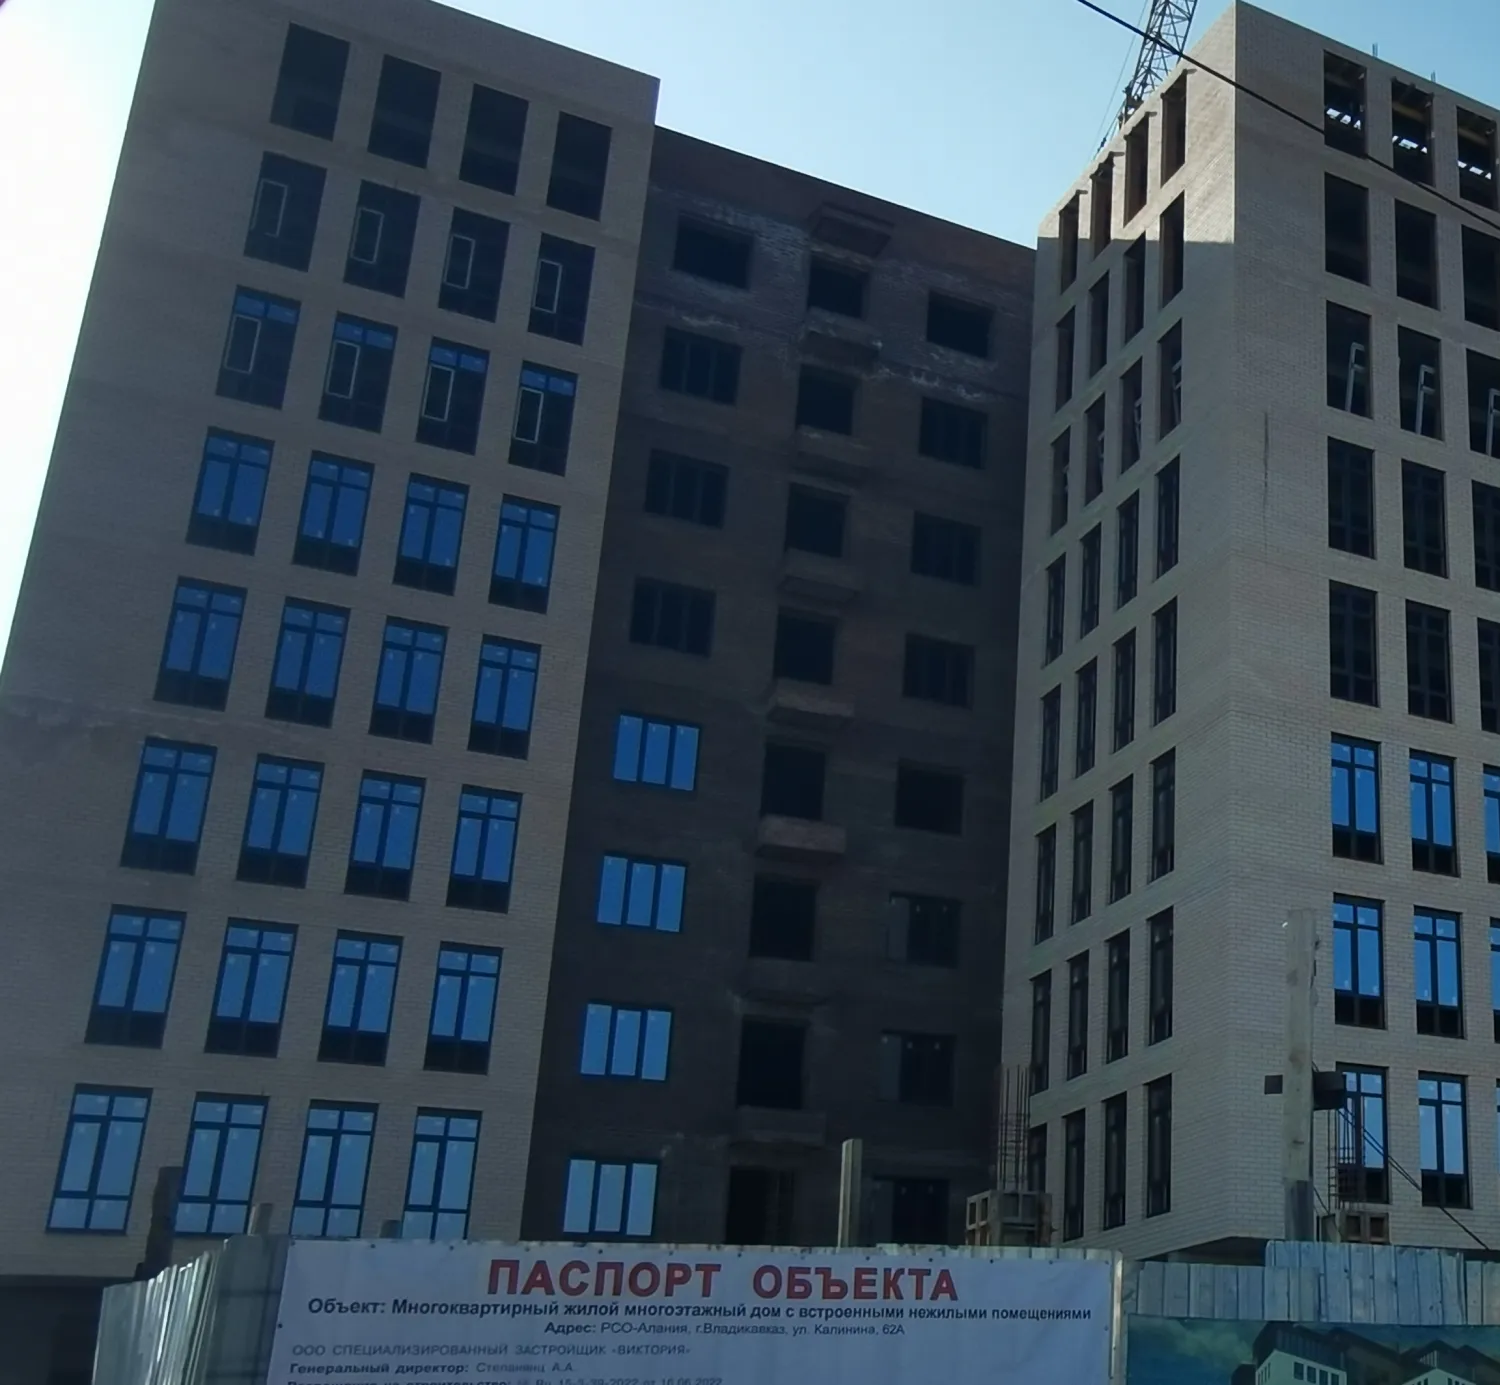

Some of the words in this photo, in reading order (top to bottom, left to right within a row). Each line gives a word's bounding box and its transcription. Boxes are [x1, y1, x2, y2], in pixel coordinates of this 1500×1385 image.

[487, 1259, 722, 1298] ПАСПОРТ
[753, 1265, 958, 1301] ОБЪЕКТА
[308, 1298, 386, 1314] Объект:
[391, 1299, 558, 1318] Многоквартирный
[564, 1302, 619, 1316] жилой
[624, 1304, 746, 1317] многоэтажный
[750, 1307, 780, 1319] дом
[785, 1307, 795, 1317] с
[799, 1307, 903, 1321] встроенными
[908, 1308, 987, 1319] нежилыми
[992, 1309, 1092, 1321] помещениями
[544, 1322, 596, 1336] Адрес:
[600, 1322, 691, 1335] РСО-Алания,
[695, 1323, 788, 1336] г.Владикавказ,
[814, 1324, 878, 1337] Калинина,
[882, 1323, 905, 1335] 62А
[292, 1344, 326, 1356] ООО
[332, 1344, 508, 1356] СПЕЦИАЛИЗИРОВАННЫЙ
[515, 1344, 607, 1356] ЗАСТРОЙЩИК
[290, 1363, 390, 1375] Генеральный
[394, 1364, 469, 1375] директор:
